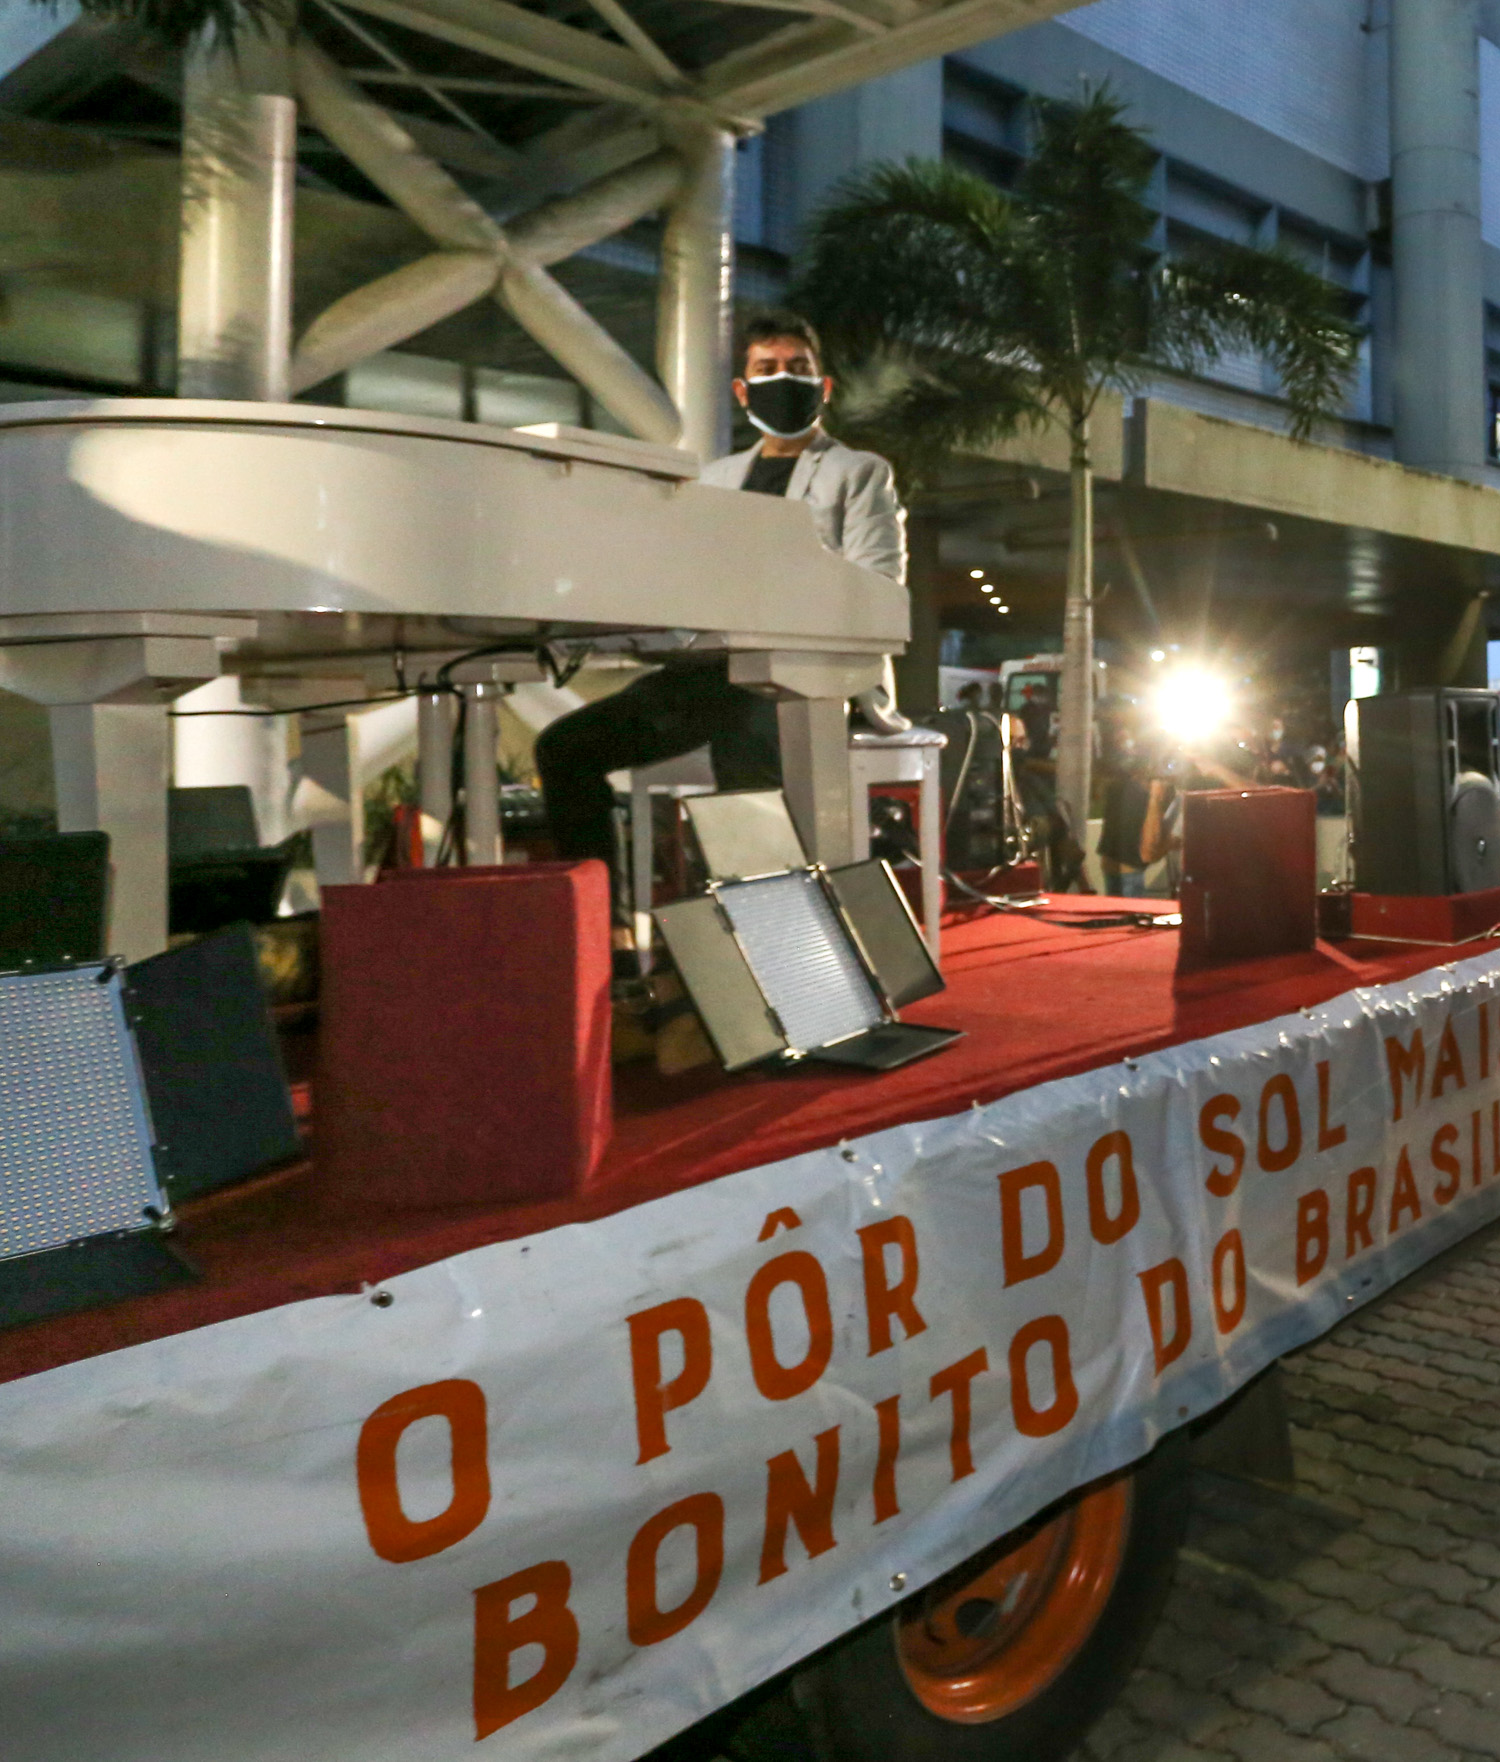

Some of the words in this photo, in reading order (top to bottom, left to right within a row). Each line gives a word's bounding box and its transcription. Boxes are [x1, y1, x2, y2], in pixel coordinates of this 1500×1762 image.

[356, 1378, 491, 1564] O
[625, 1207, 927, 1466] PÔR
[998, 1131, 1141, 1287] DO
[1200, 1061, 1347, 1197] SOL
[473, 1315, 1079, 1742] BONITO
[1137, 1228, 1247, 1376] DO
